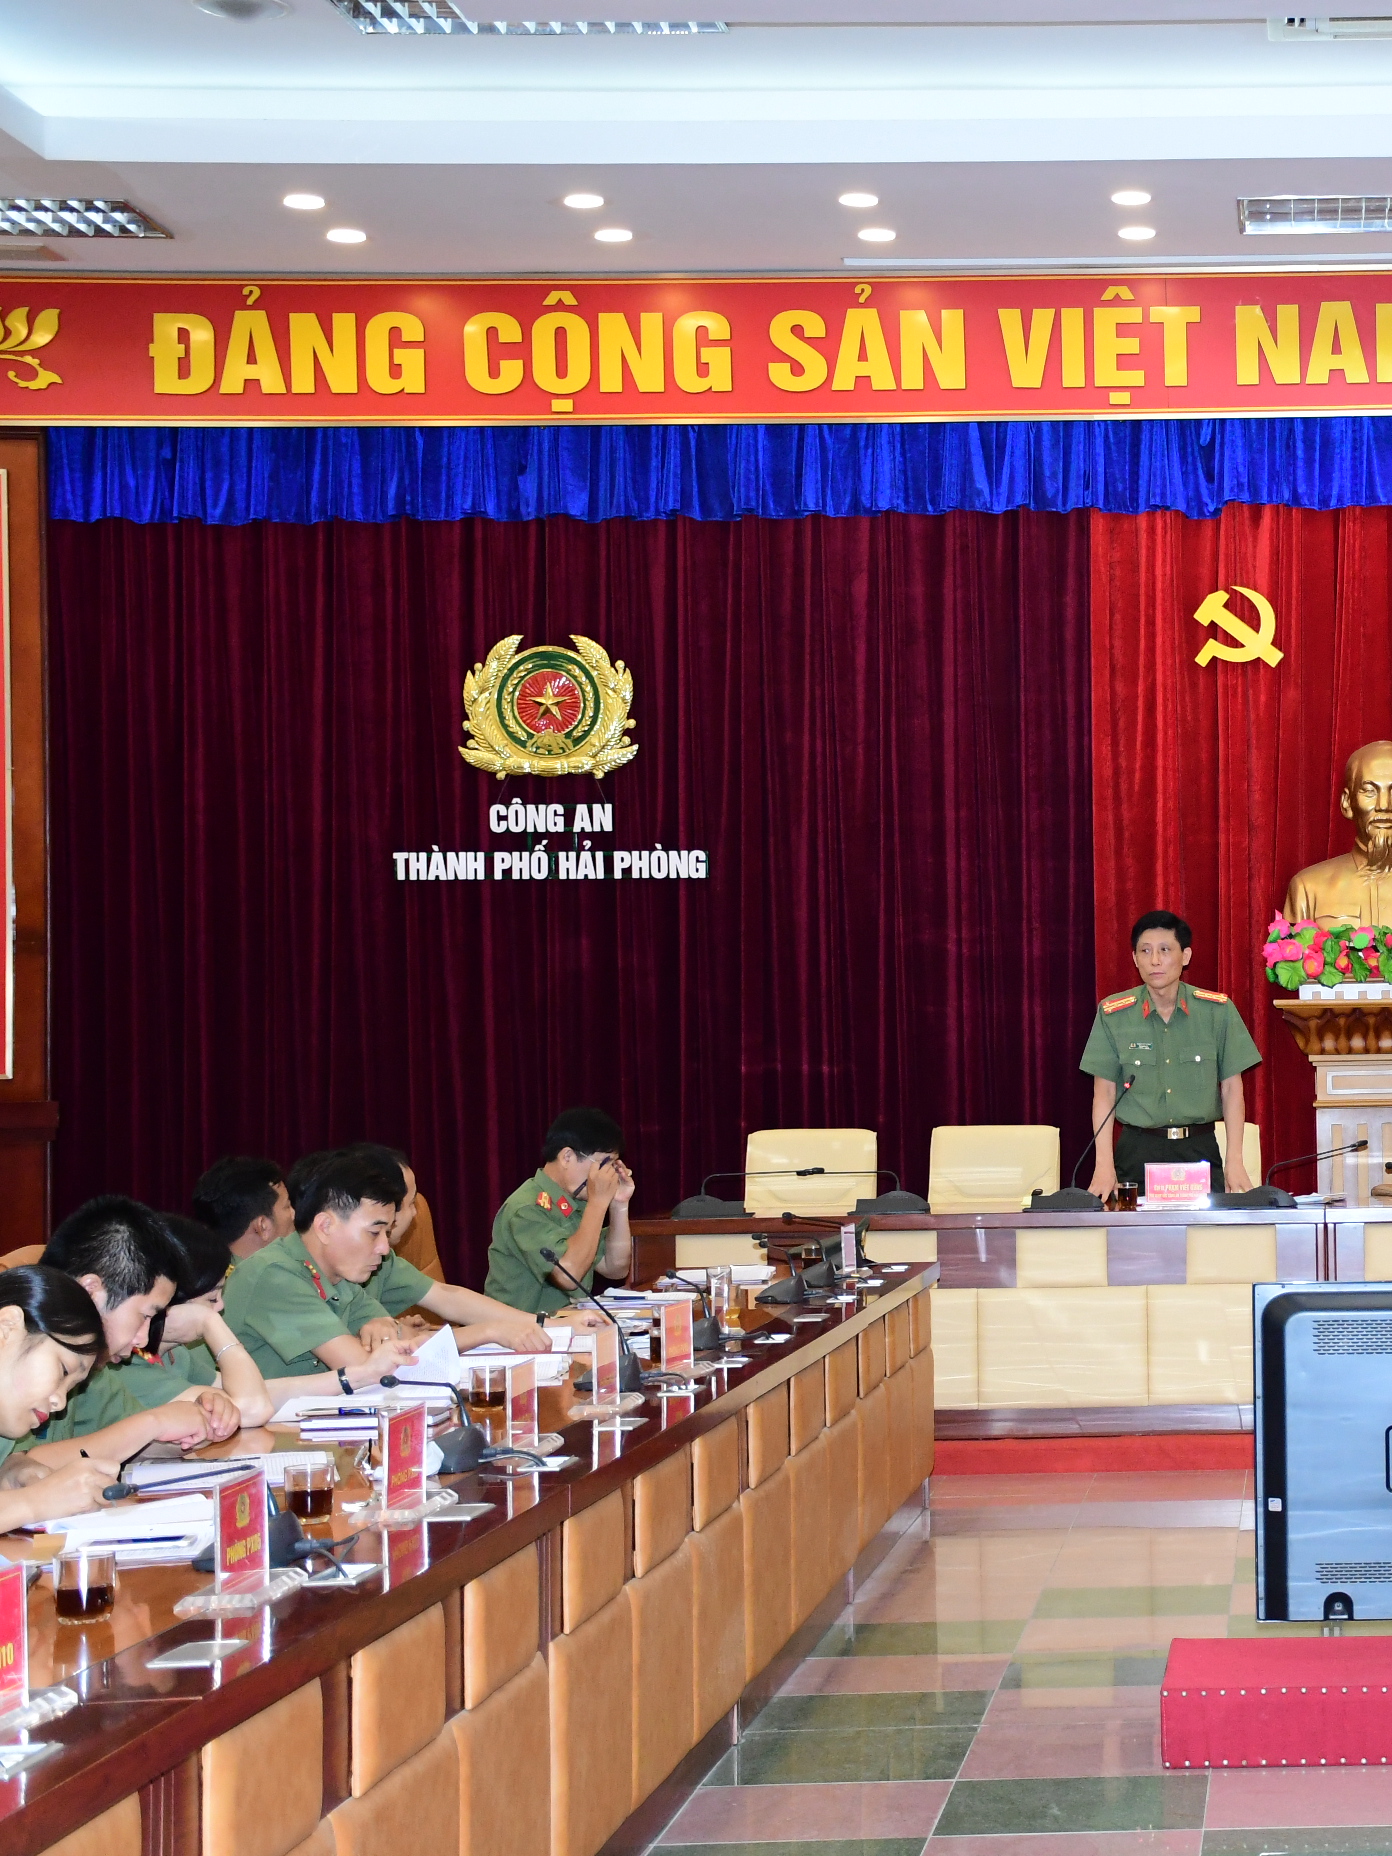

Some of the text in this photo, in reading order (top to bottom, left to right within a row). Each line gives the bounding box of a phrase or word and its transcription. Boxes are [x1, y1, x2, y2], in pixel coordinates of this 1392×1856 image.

[149, 286, 425, 394] ĐẢNG
[463, 291, 732, 412] CỘNG
[768, 284, 965, 391] SẢN
[998, 286, 1200, 406] VIỆT
[490, 798, 612, 833] CÔNG AN
[393, 839, 706, 880] THÀNH PHỐ HẢI PHÒNG
[226, 1539, 247, 1567] PHÒNG
[0, 1642, 14, 1668] 10
